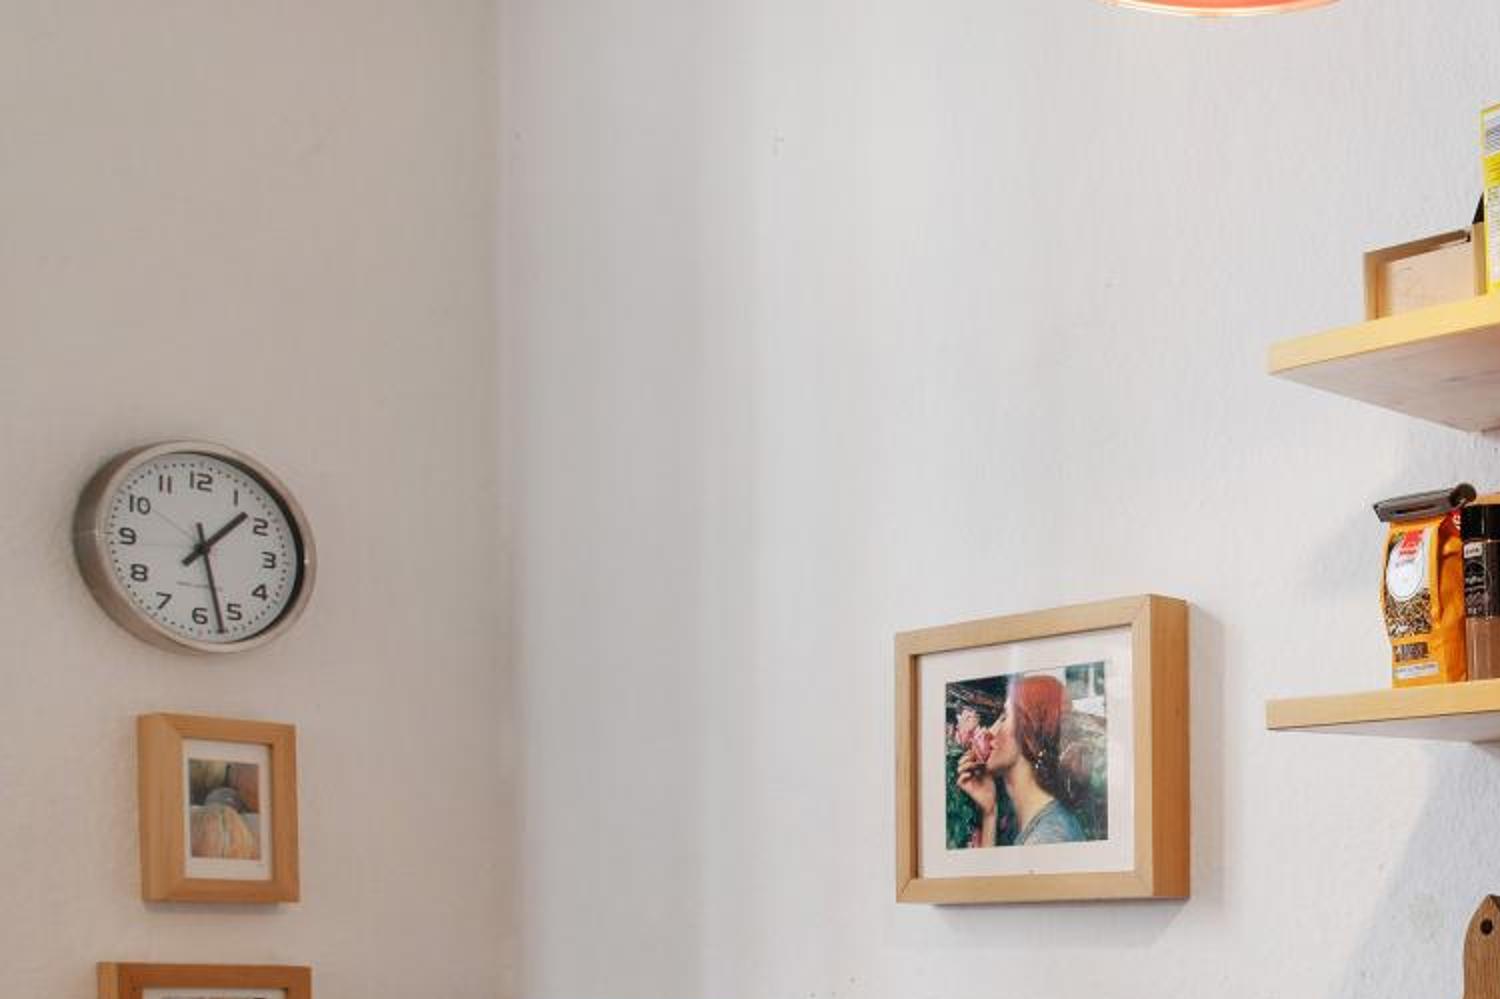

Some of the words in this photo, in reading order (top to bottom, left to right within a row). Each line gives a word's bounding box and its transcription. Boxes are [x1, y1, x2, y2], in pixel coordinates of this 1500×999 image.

[158, 475, 172, 493] 11
[189, 471, 213, 492] 12
[128, 495, 151, 515] 10
[119, 527, 137, 545] 9
[252, 518, 269, 536] 2
[261, 551, 277, 569] 3
[130, 563, 149, 582] 8
[155, 592, 172, 609] 7
[251, 584, 268, 600] 4
[191, 607, 208, 625] 6
[226, 603, 243, 621] 5
